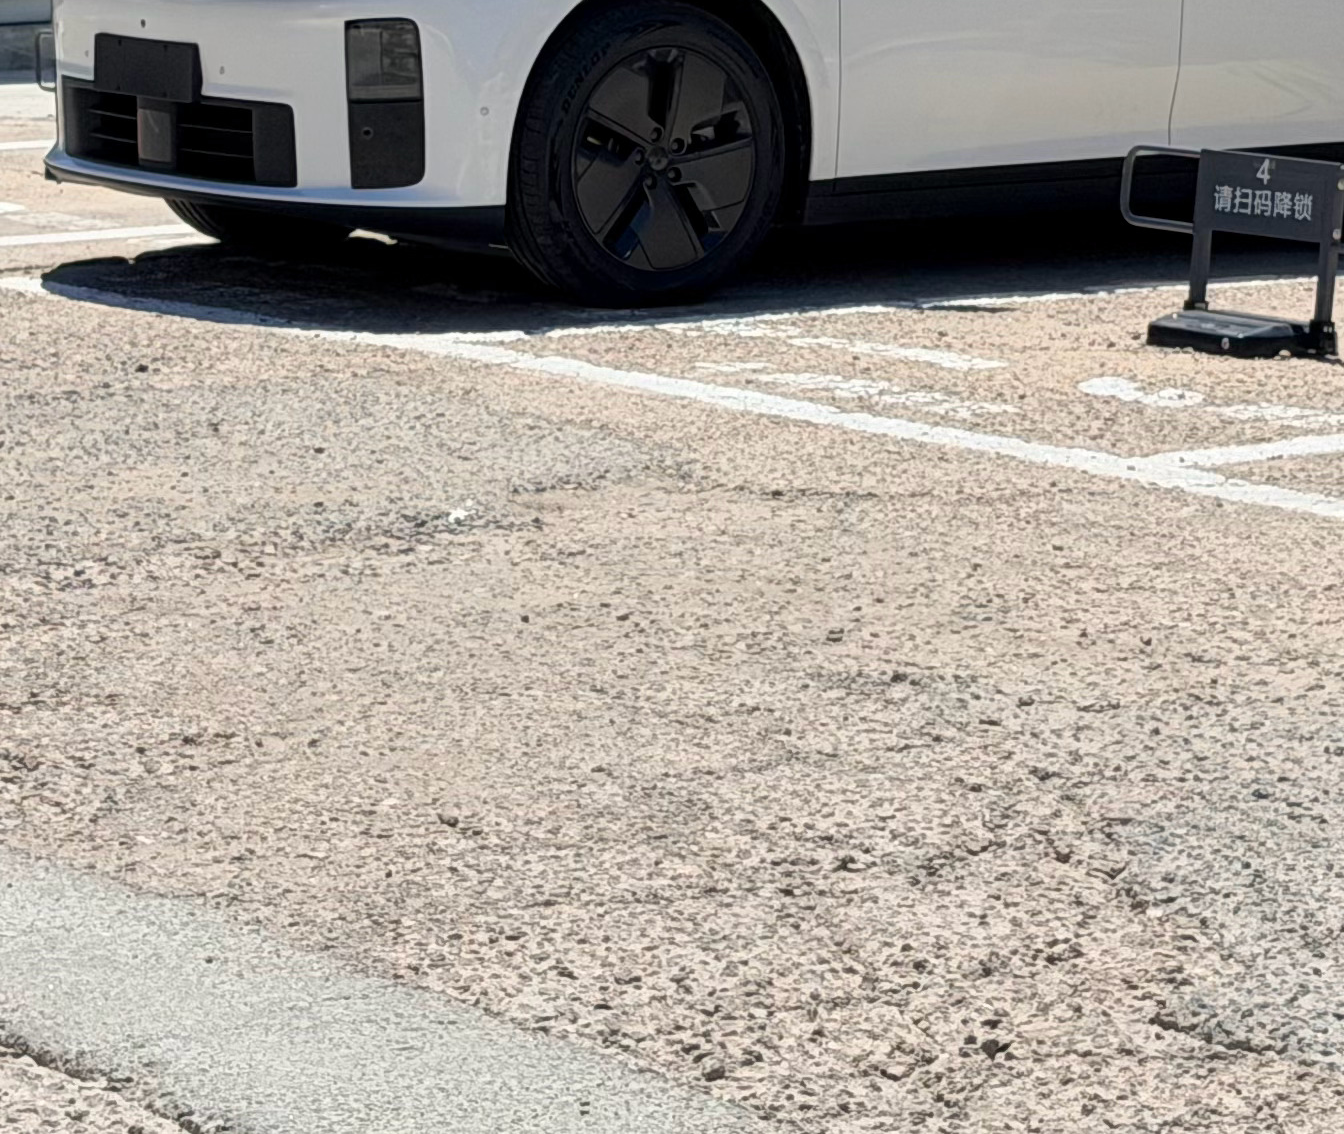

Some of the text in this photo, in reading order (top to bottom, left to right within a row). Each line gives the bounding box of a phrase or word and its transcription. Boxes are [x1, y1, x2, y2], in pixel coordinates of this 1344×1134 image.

[1256, 158, 1271, 185] 4
[1213, 184, 1314, 222] 请扫码降锁
